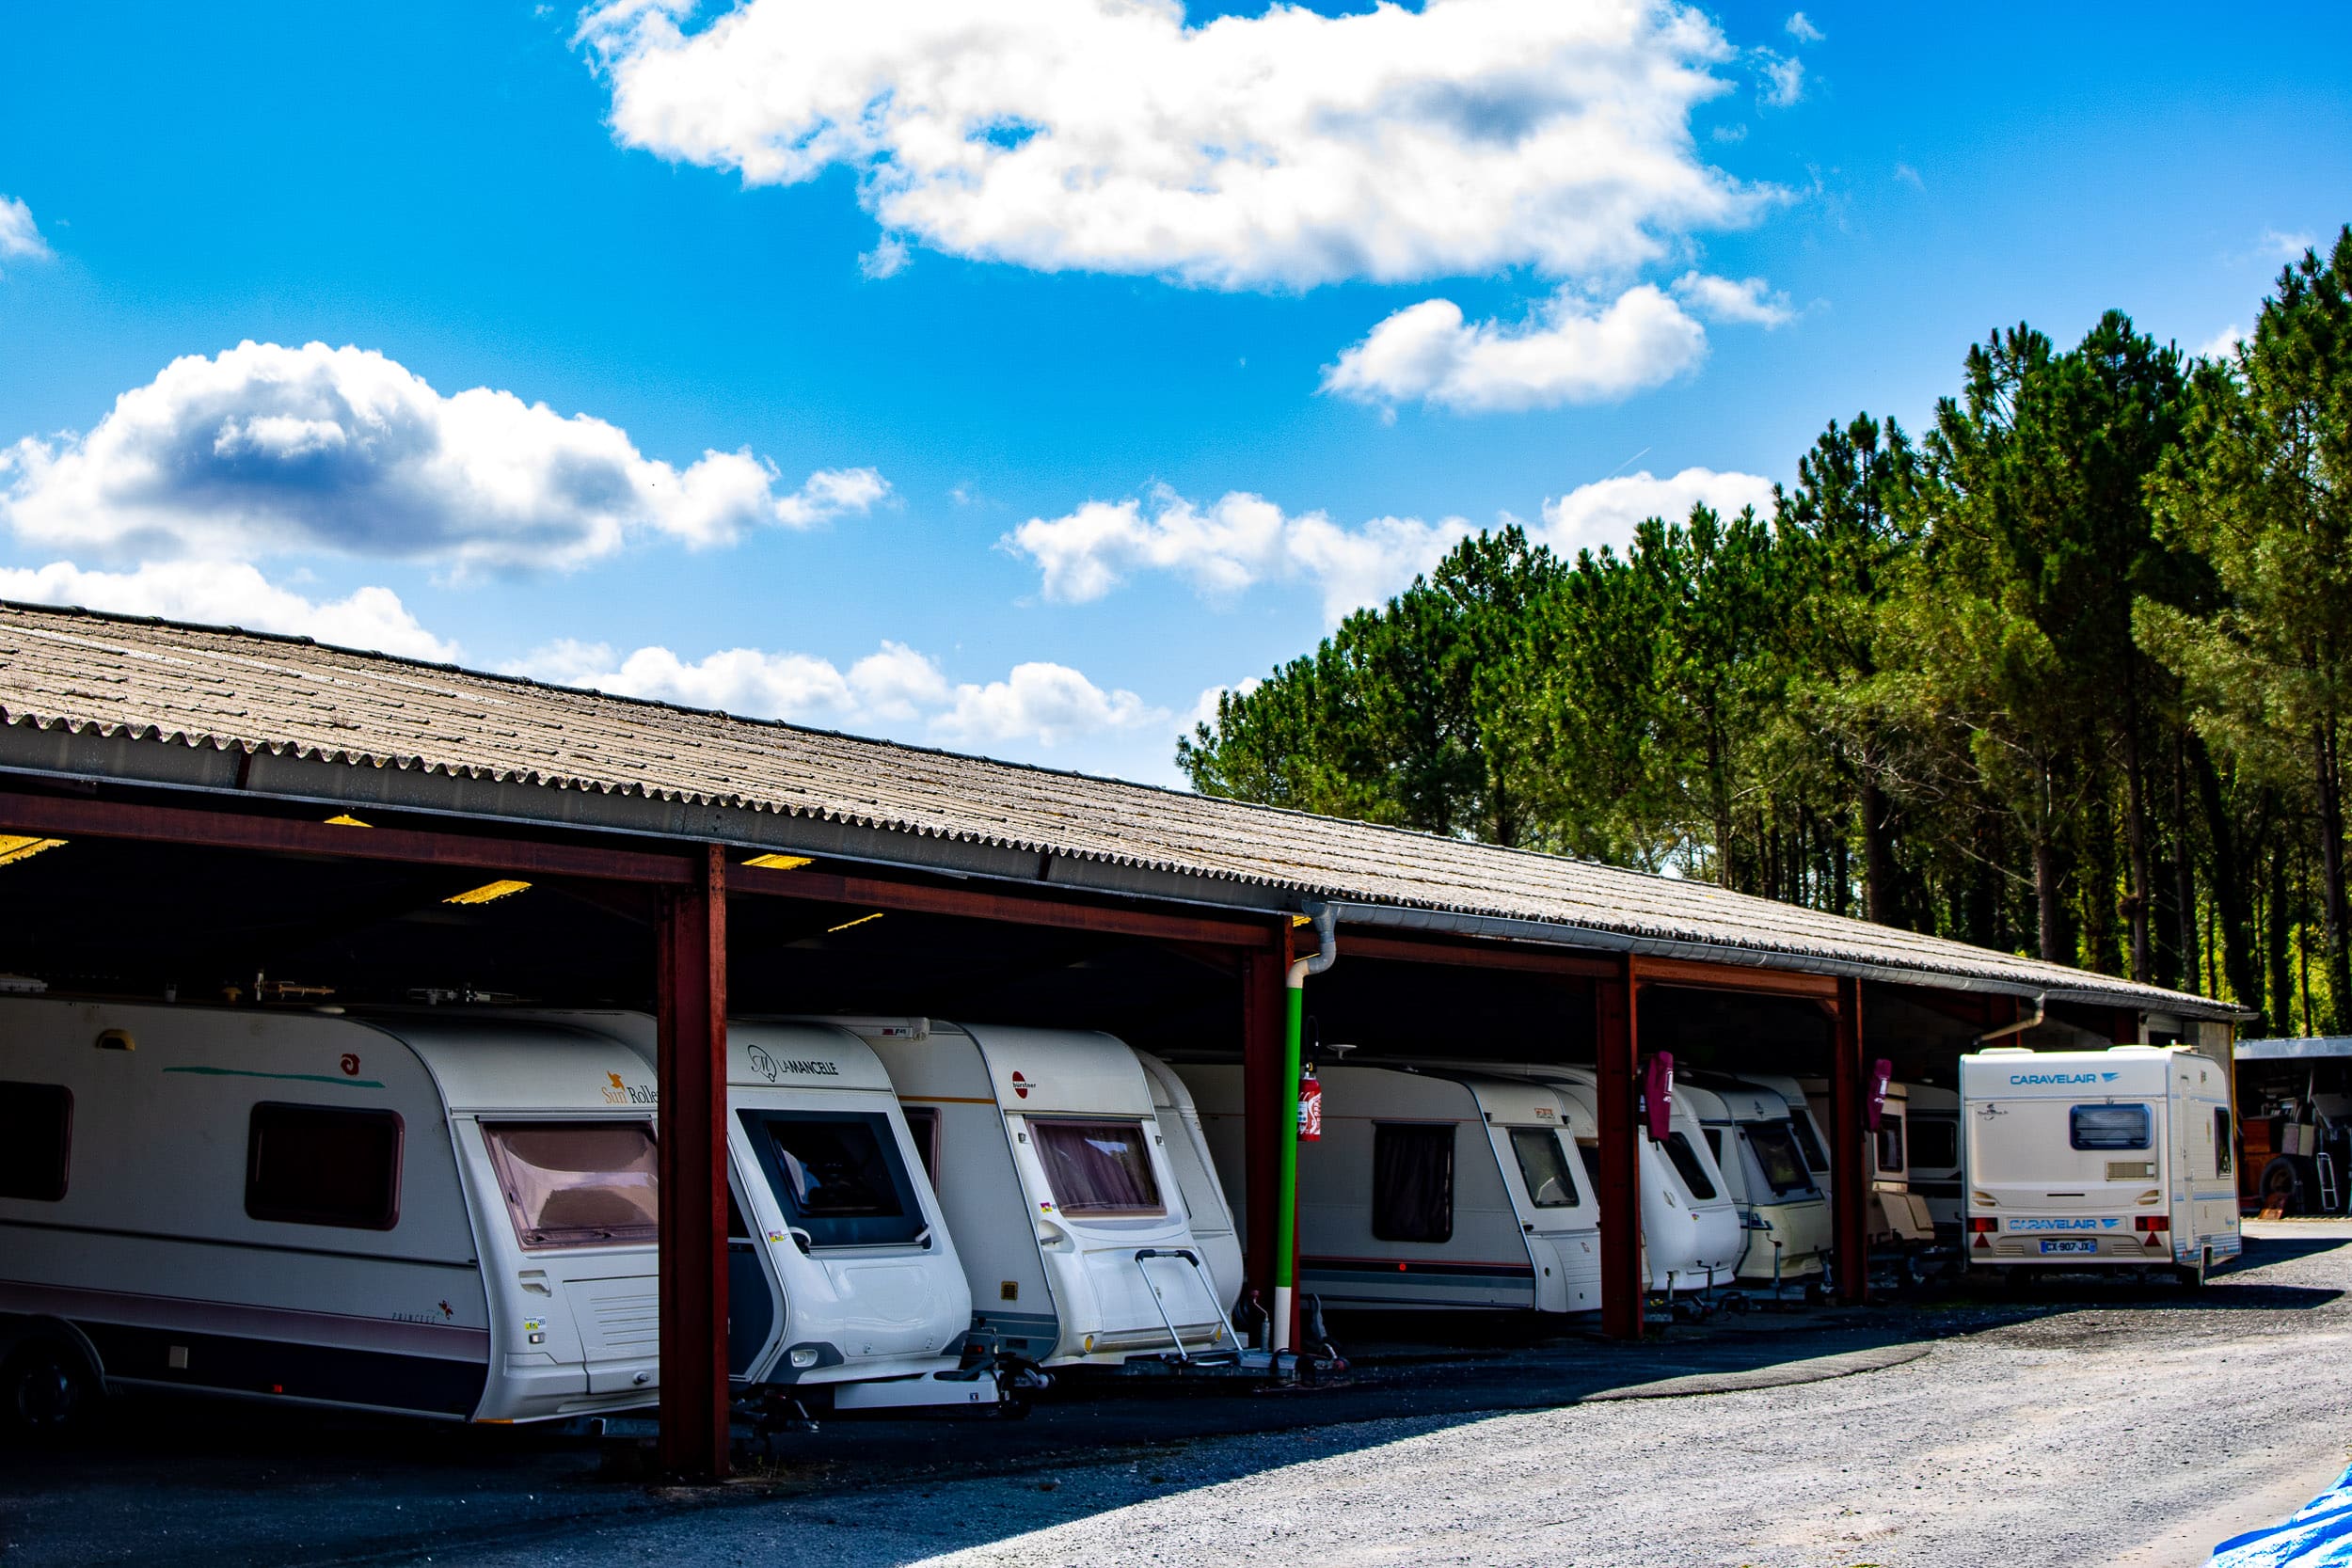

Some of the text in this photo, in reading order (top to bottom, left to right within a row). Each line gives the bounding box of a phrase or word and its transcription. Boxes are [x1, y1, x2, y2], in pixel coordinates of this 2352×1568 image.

[2010, 1073, 2097, 1085] CARAVELAIR
[602, 1085, 658, 1103] Sun Rolle
[2010, 1218, 2097, 1229] CARAVELAIR
